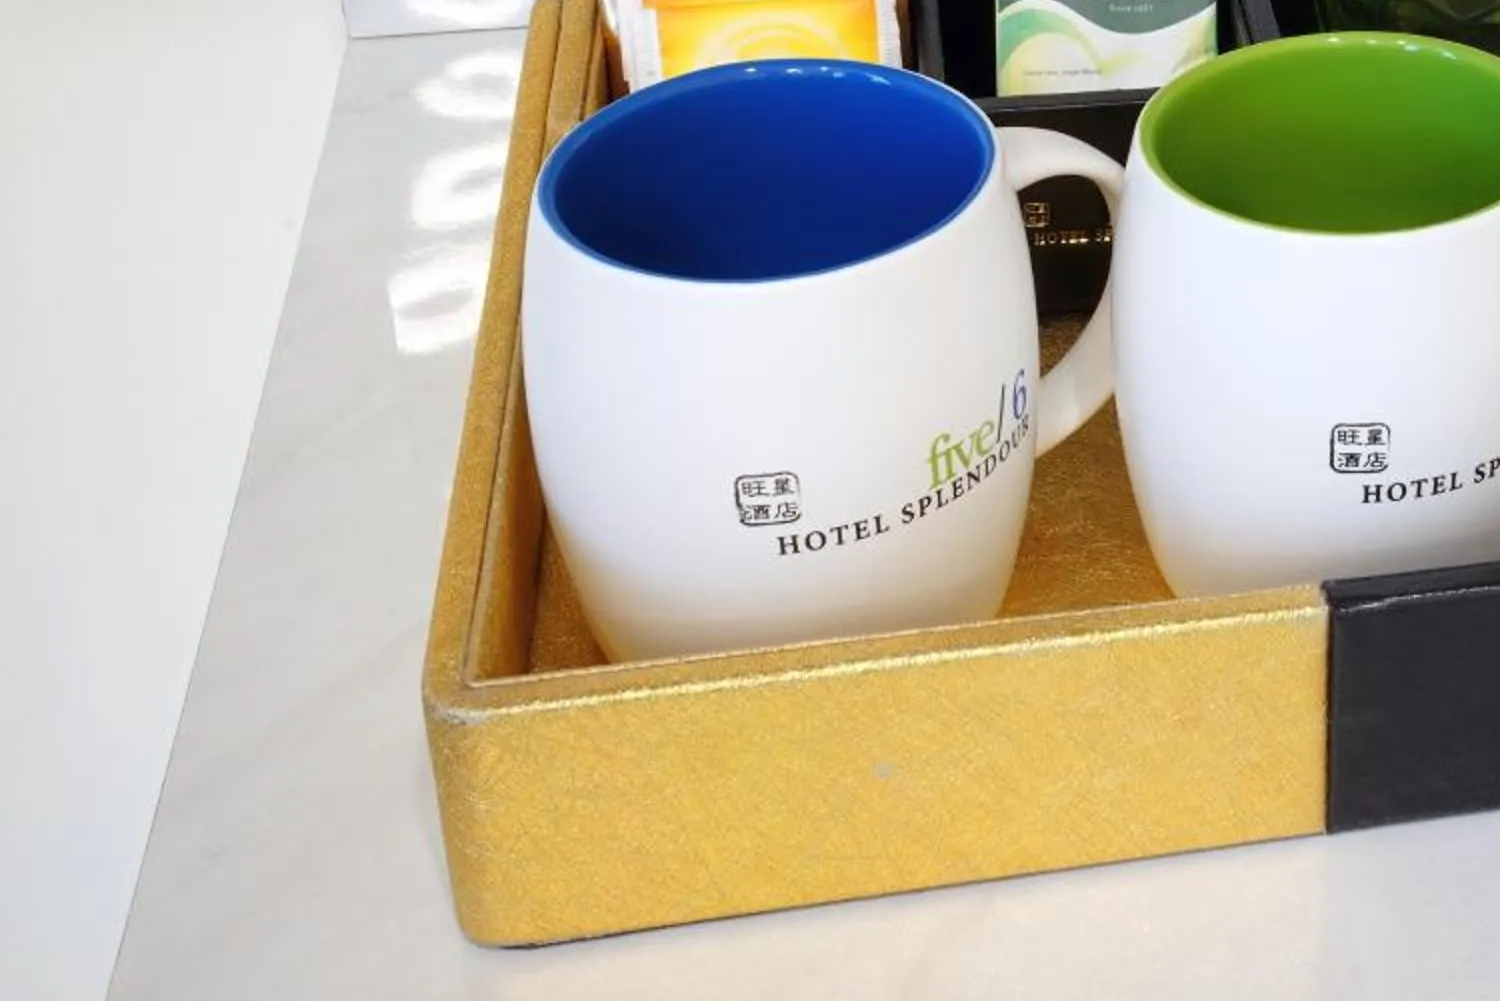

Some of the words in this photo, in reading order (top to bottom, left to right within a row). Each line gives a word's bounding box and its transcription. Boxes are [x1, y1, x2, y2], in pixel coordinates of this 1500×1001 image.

[778, 515, 890, 556] HOTEL
[901, 413, 1030, 525] SPLENDOUR
[1362, 473, 1463, 504] HOTEL
